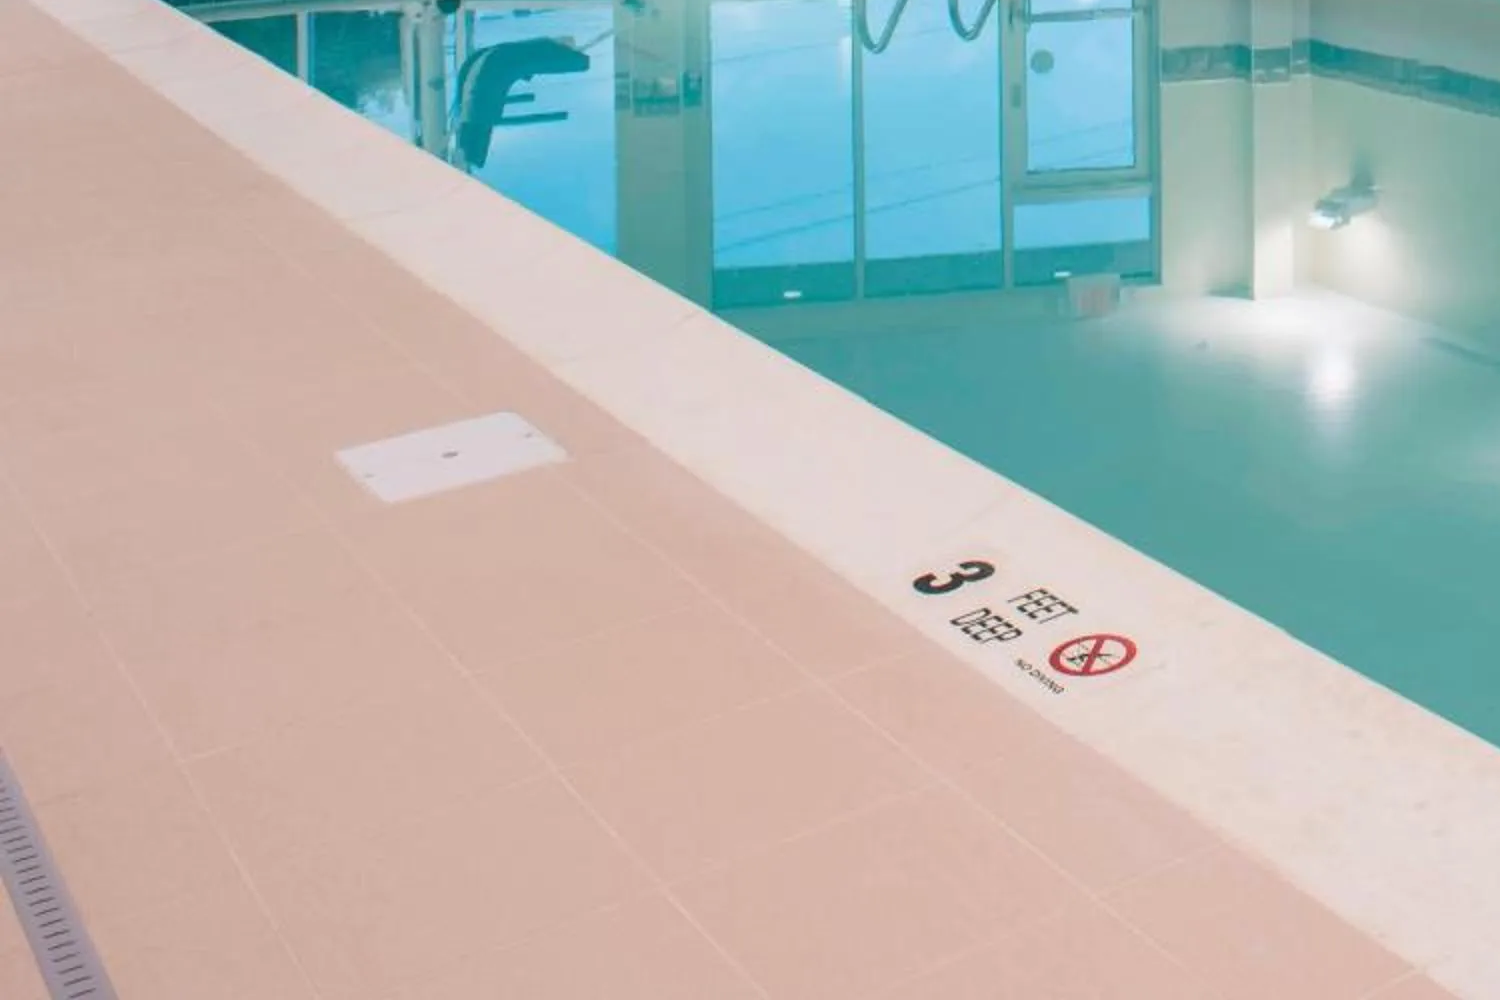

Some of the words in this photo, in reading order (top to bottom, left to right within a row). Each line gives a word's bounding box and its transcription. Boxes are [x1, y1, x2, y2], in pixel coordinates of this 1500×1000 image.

[912, 560, 996, 595] 3
[1006, 588, 1079, 625] FEET
[949, 607, 1023, 645] DEEP
[1015, 658, 1032, 671] NO
[1029, 669, 1065, 694] DIVING
